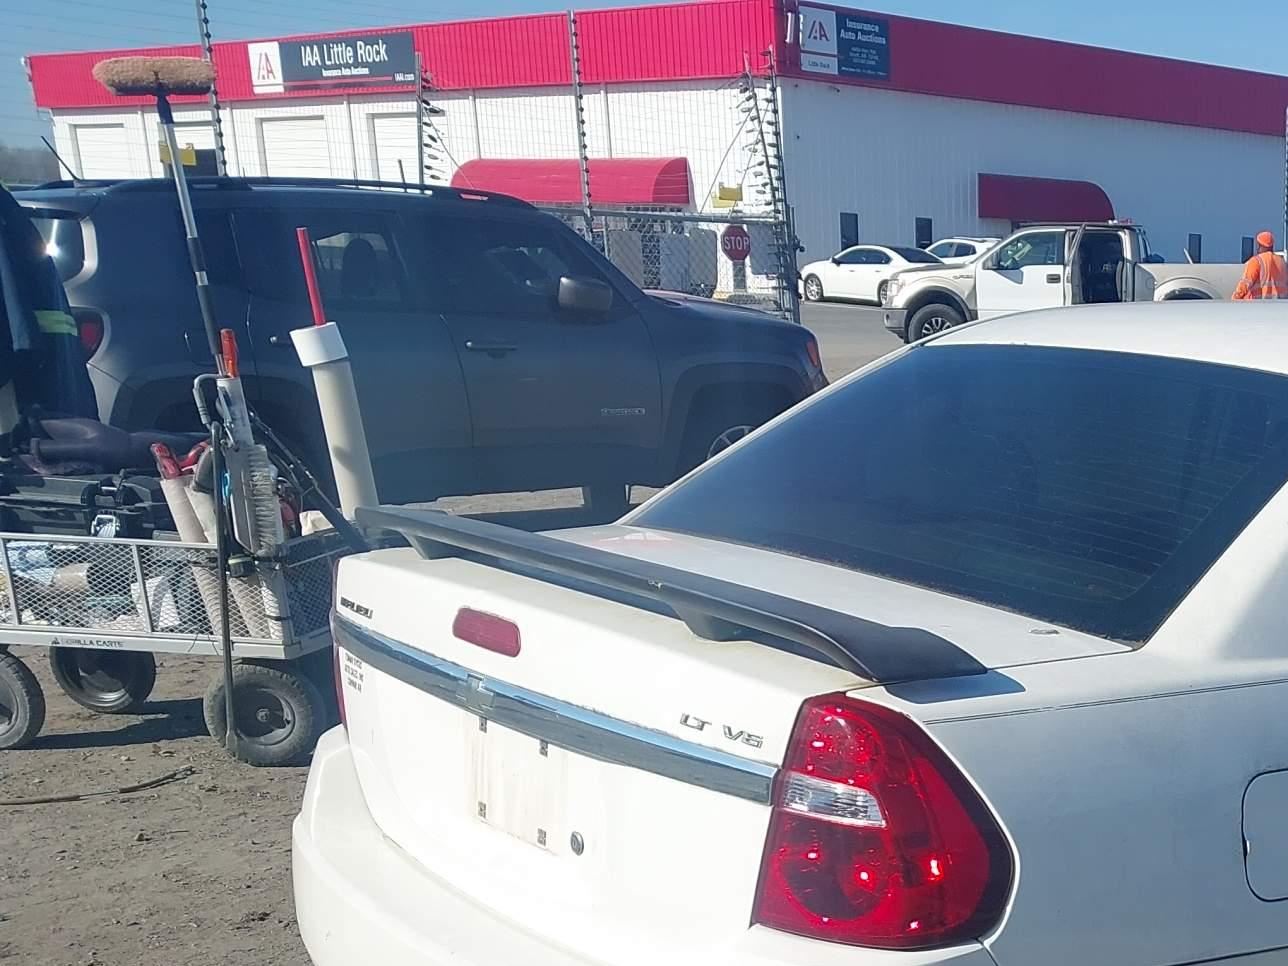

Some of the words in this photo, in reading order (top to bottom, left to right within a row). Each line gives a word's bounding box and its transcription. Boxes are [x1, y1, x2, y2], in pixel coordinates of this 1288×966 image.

[840, 29, 856, 40] Auto
[301, 46, 322, 67] IAA
[323, 42, 354, 65] Little
[356, 39, 389, 63] Rock
[725, 236, 749, 250] STOP
[680, 712, 712, 731] LT
[723, 724, 763, 748] V6
